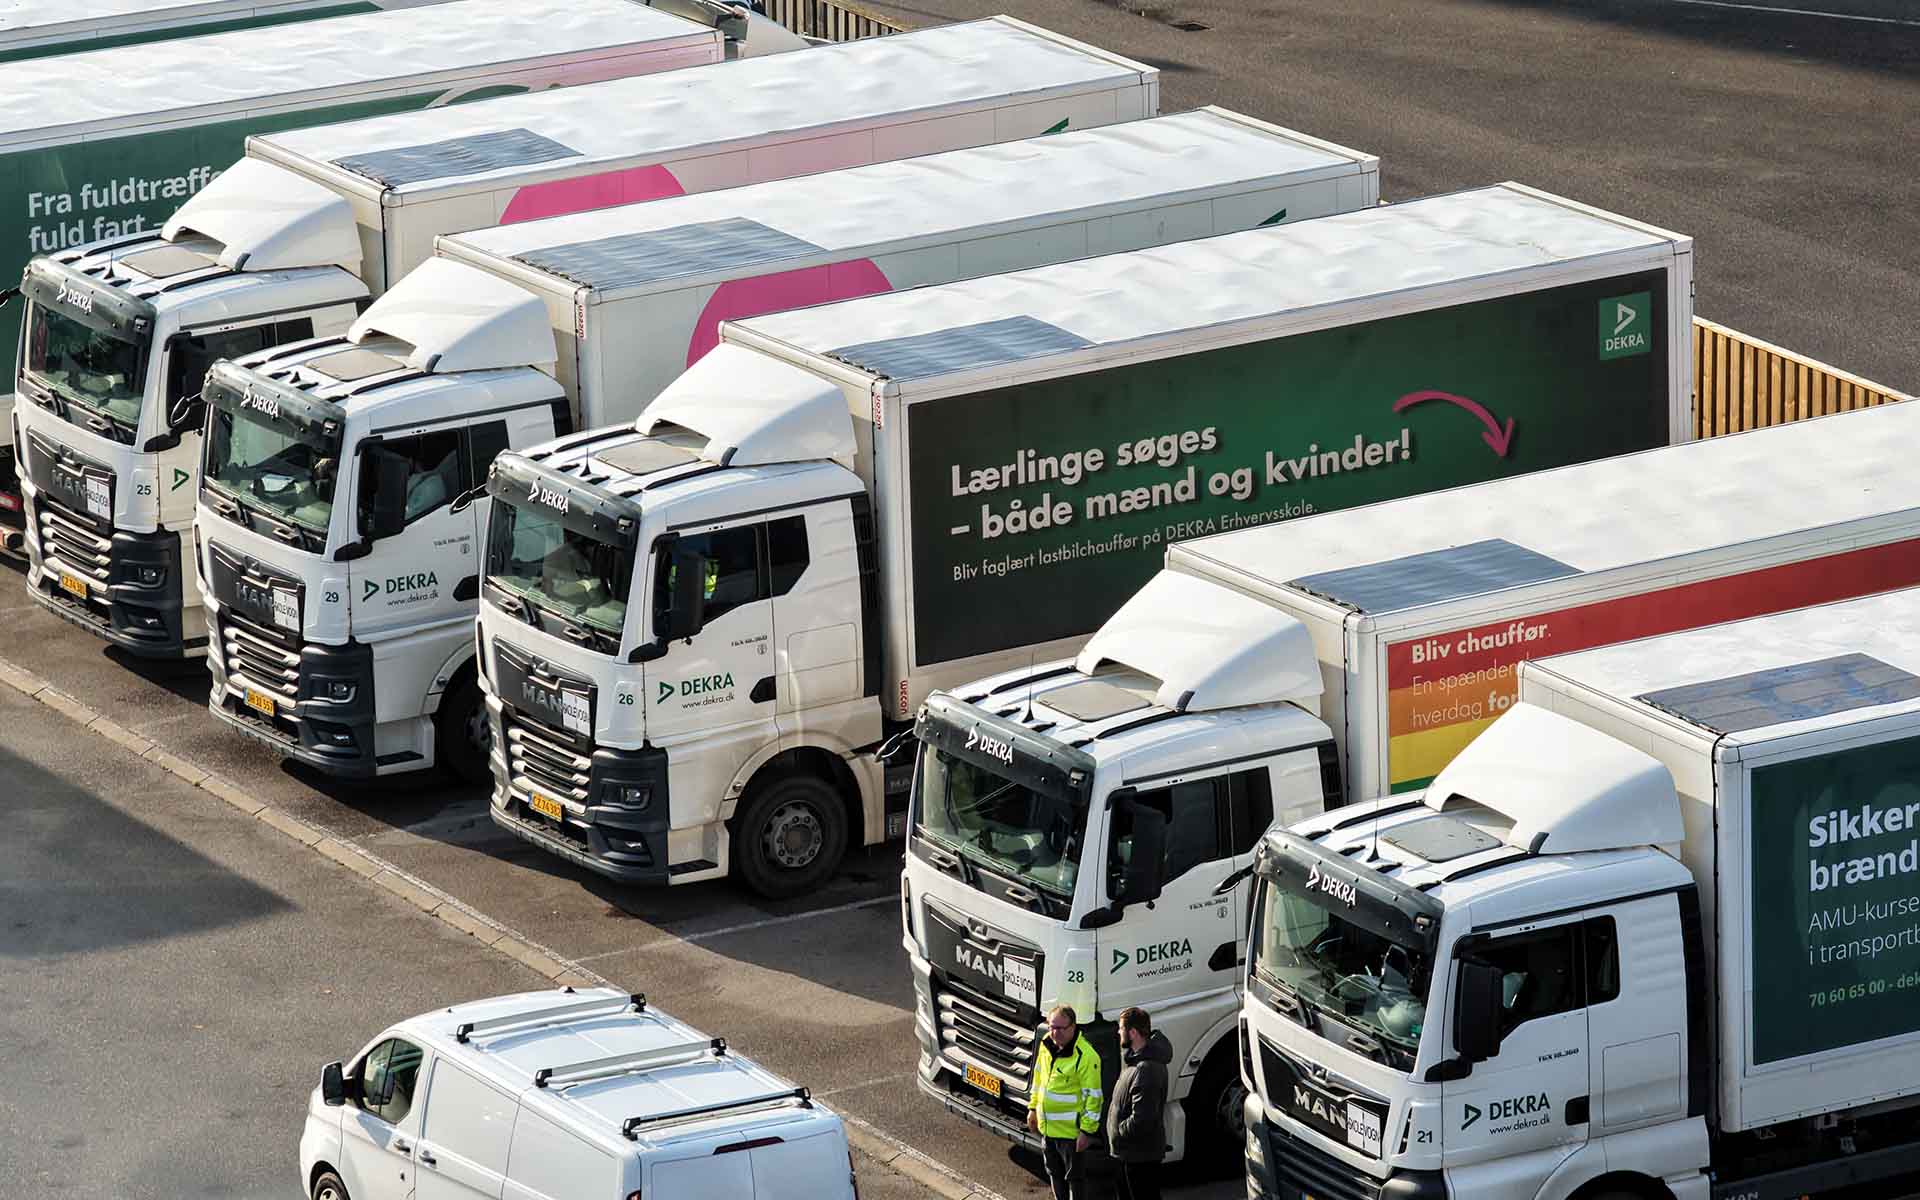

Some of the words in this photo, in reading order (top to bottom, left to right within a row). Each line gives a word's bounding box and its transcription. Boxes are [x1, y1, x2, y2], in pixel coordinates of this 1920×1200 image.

[28, 192, 72, 218] Fra
[28, 219, 84, 253] fuld
[67, 289, 92, 313] DEKRA
[1606, 333, 1644, 351] DEKRA
[252, 394, 279, 417] DEKRA
[951, 447, 1104, 497] Lærlinge
[1115, 426, 1217, 467] søges
[52, 468, 87, 500] MAN
[137, 484, 152, 495] 25
[540, 483, 569, 513] DEKRA
[981, 493, 1073, 540] både
[1086, 467, 1196, 519] mænd
[1208, 466, 1253, 500] og
[1265, 429, 1411, 485] kvinder!
[953, 563, 978, 581] Bliv
[982, 551, 1035, 577] faglært
[1039, 535, 1139, 566] lastbilchauffør
[1143, 527, 1161, 549] på
[1166, 517, 1216, 540] DEKRA
[1221, 499, 1317, 530] Erhvervsskole.
[386, 571, 438, 594] DEKRA
[325, 592, 339, 603] 29
[1412, 642, 1451, 664] Bliv
[1457, 621, 1551, 655] chauffør.
[522, 681, 561, 713] MAN
[681, 672, 734, 696] DEKRA
[1413, 675, 1432, 696] En
[618, 693, 634, 705] 26
[682, 692, 734, 709] www.dekra.dk
[1413, 698, 1482, 728] hverdag
[980, 735, 1013, 764] DEKRA
[1809, 802, 1920, 847] Sikker
[1810, 840, 1917, 891] brænd
[1321, 876, 1356, 906] DEKRA
[1808, 896, 1920, 933] AMU-kurse
[956, 944, 1003, 982] MAN
[1136, 938, 1192, 965] DEKRA
[1809, 945, 1813, 965] i
[1067, 970, 1084, 983] 28
[1137, 959, 1193, 978] www.dekra.dk
[1809, 991, 1825, 1008] 70
[1829, 988, 1845, 1003] 60
[1849, 983, 1865, 998] 65
[1868, 979, 1885, 993] 00
[1294, 1085, 1347, 1130] MAN
[1489, 1093, 1550, 1120] DEKRA
[1417, 1131, 1433, 1143] 21
